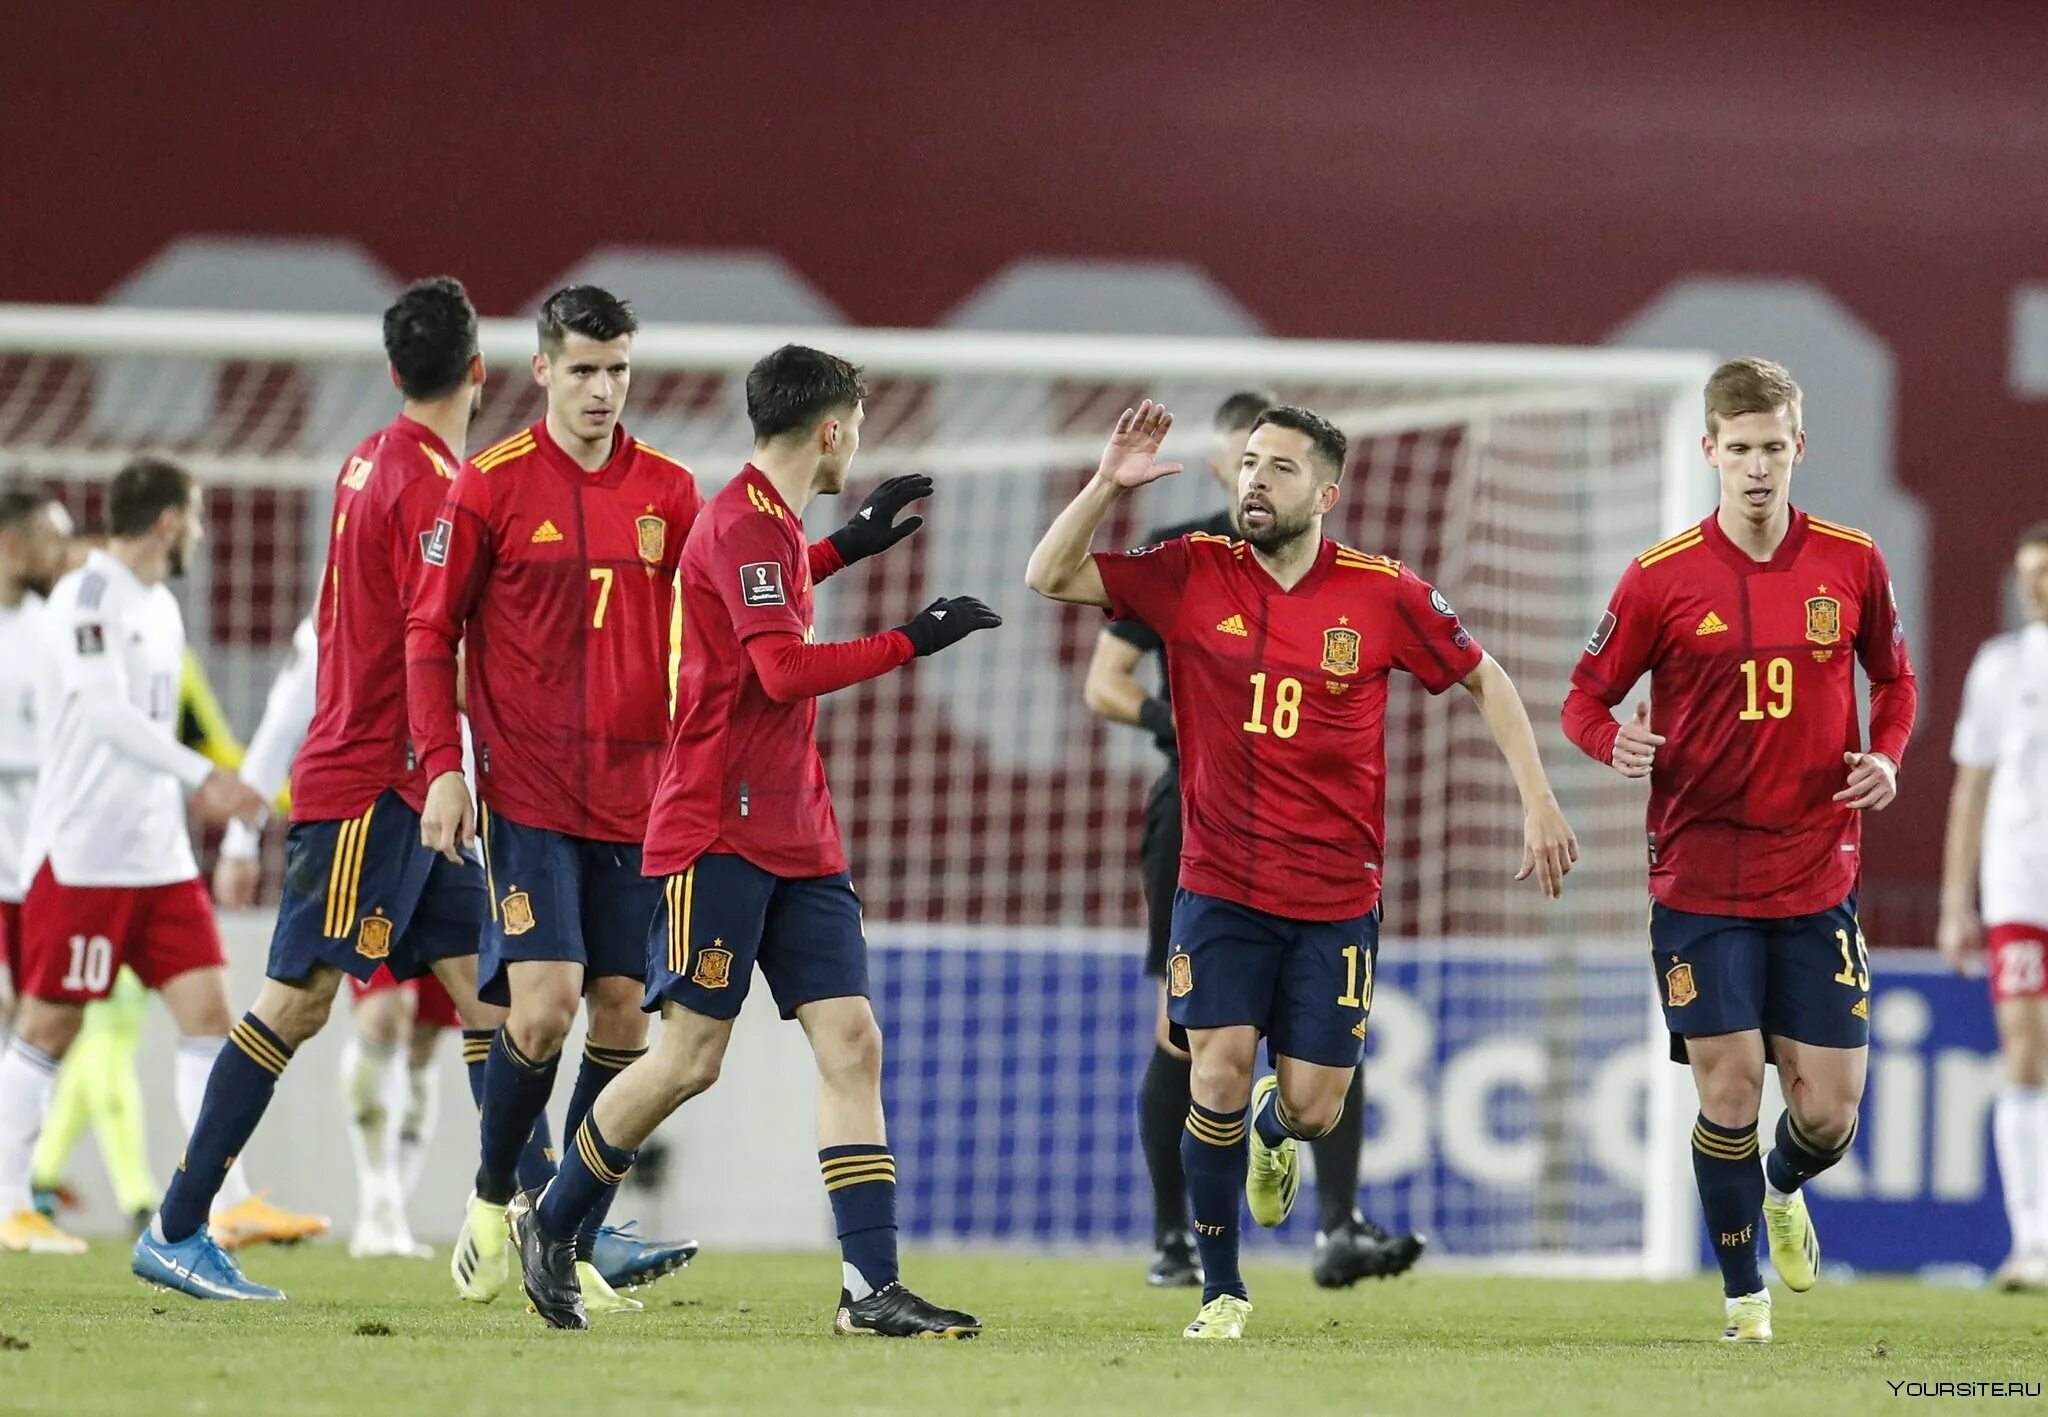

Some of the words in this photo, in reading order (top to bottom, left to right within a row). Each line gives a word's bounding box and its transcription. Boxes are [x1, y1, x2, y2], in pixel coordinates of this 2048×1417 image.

[590, 568, 613, 629] 7
[1216, 622, 1248, 637] adidas
[1696, 623, 1729, 636] adidas
[1243, 671, 1303, 739] 18
[1739, 656, 1793, 721] 19
[61, 934, 114, 993] 10
[1337, 945, 1372, 1011] 18
[1721, 1223, 1753, 1247] RFEF
